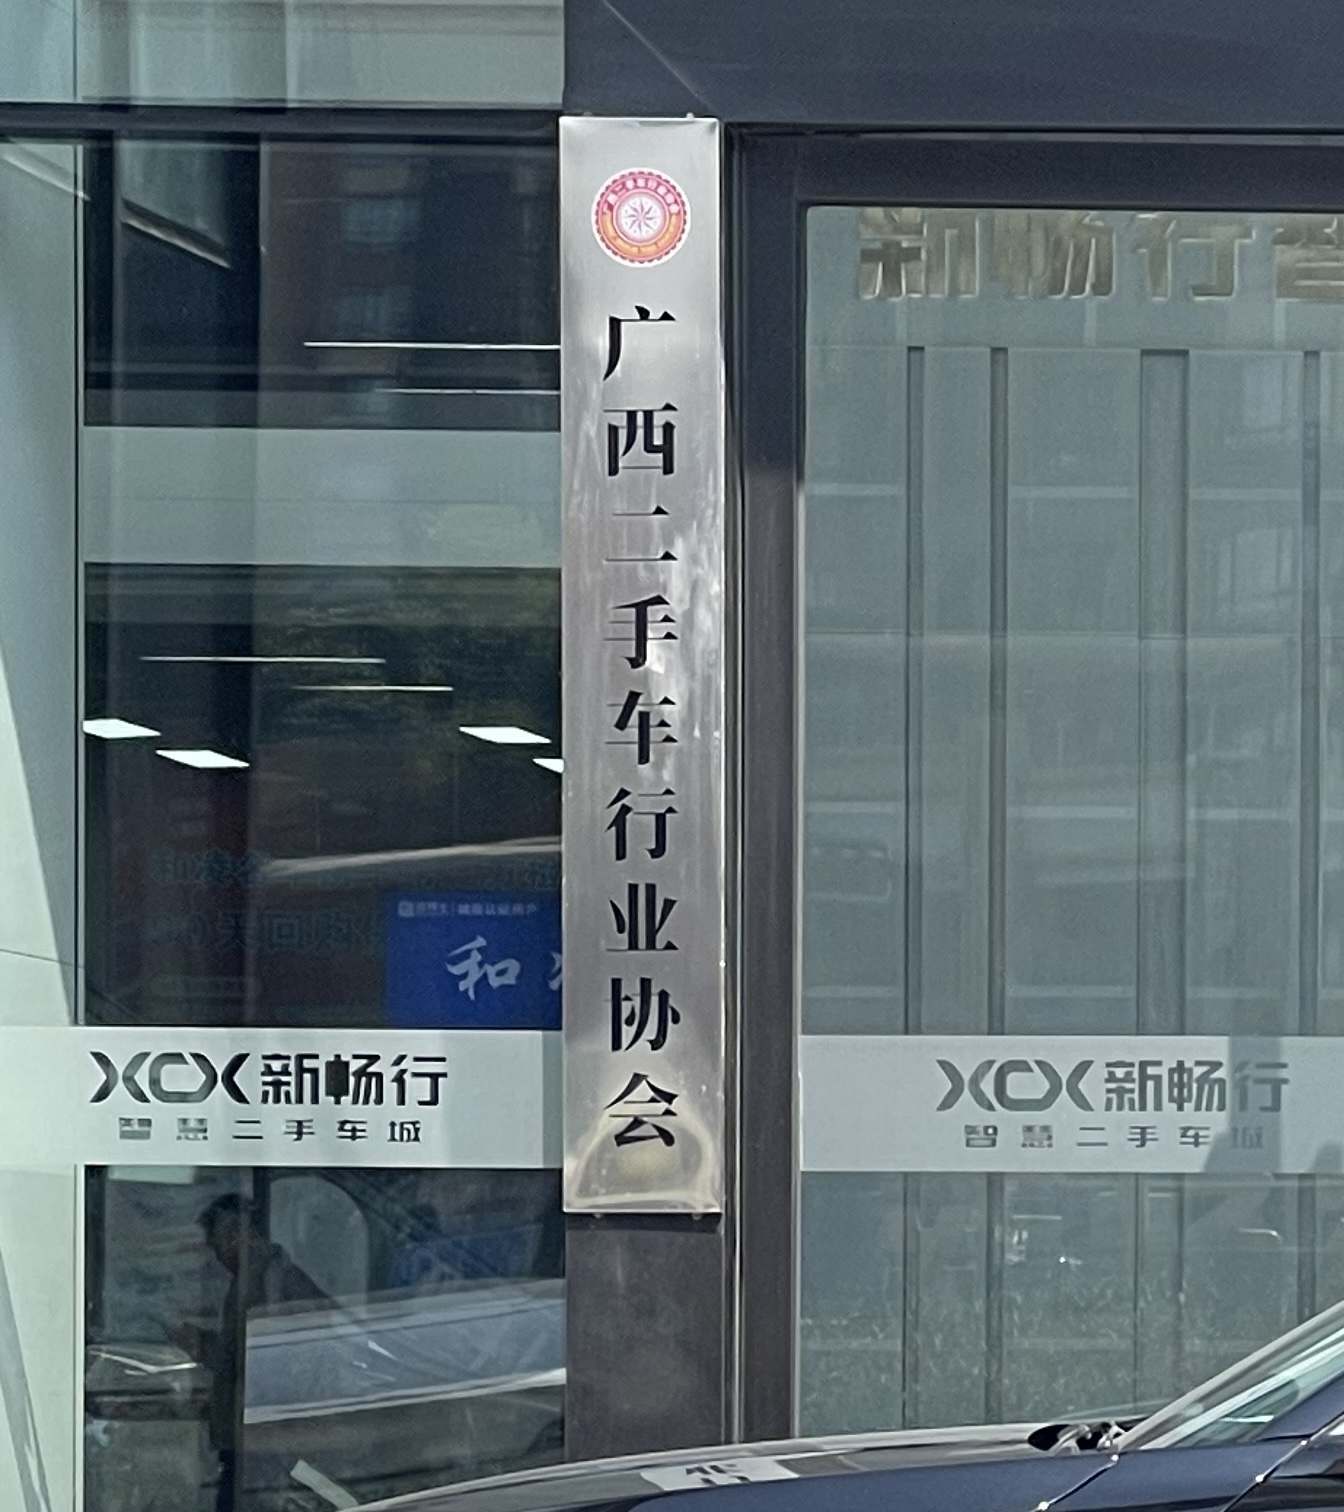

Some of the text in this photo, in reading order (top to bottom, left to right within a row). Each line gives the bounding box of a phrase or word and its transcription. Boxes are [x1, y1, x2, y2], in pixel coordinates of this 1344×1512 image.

[602, 304, 681, 1150] 广西二手车行业协会
[260, 1053, 448, 1107] 新畅行
[1103, 1060, 1290, 1114] 新畅行
[964, 1124, 1265, 1150] 智慧二手车城
